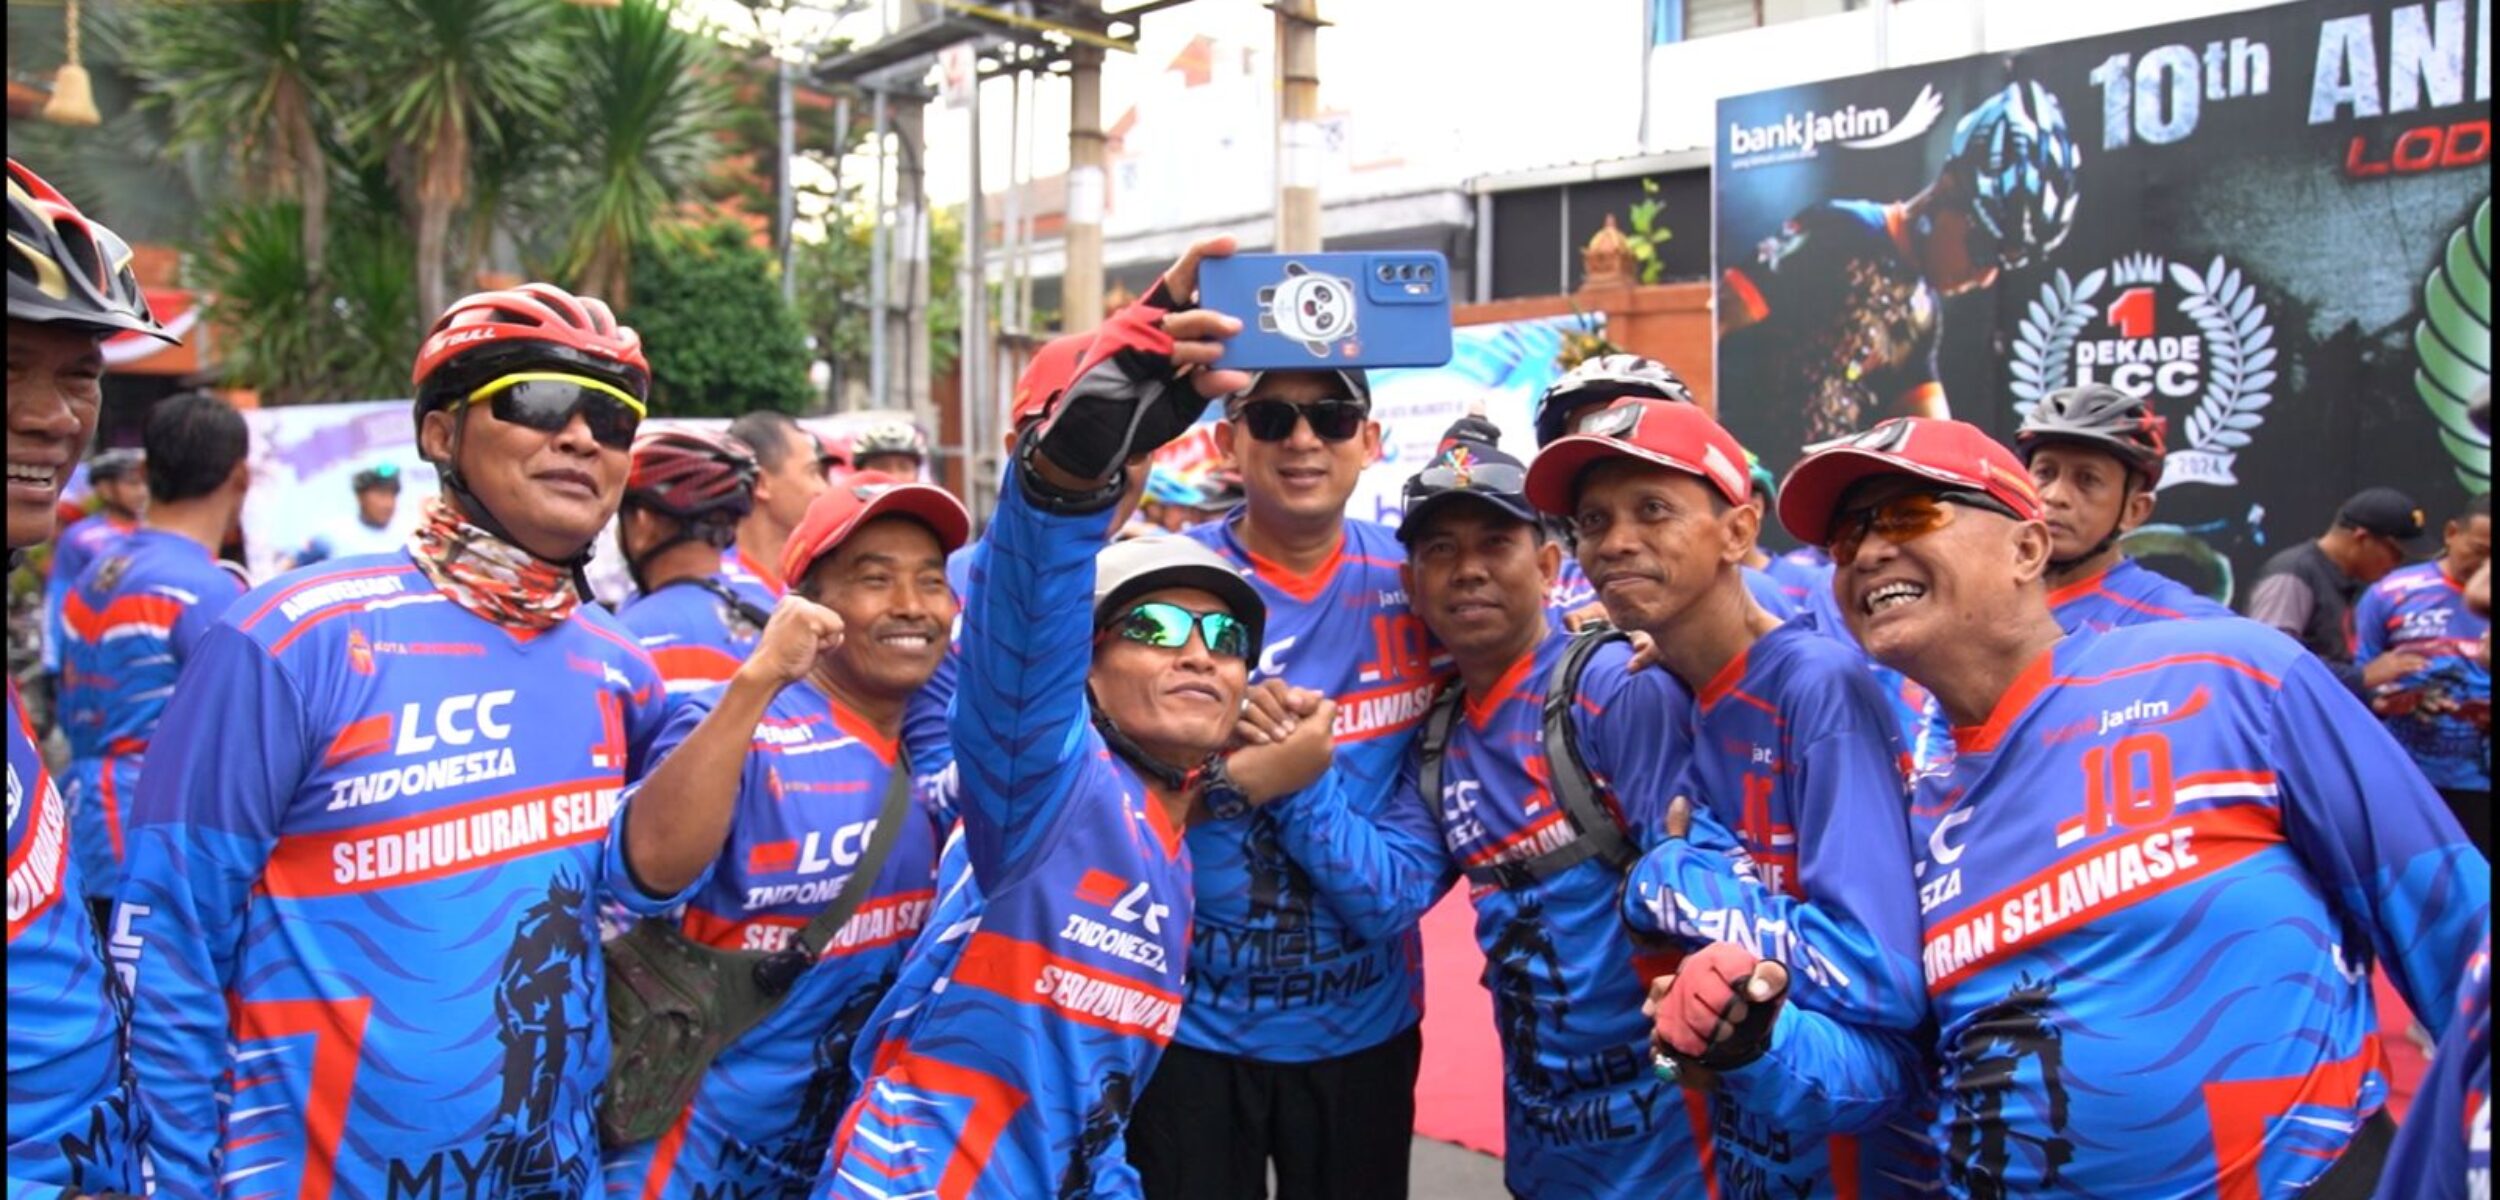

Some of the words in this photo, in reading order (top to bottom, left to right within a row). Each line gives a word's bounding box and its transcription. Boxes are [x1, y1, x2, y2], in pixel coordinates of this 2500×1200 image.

[2090, 37, 2270, 151] 10th
[1731, 106, 1890, 155] bankjatim
[2107, 287, 2156, 338] 1
[2076, 334, 2201, 366] DEKADE
[2178, 455, 2222, 476] 2024
[394, 689, 516, 757] LCC
[327, 746, 517, 812] INDONESIA
[2056, 731, 2175, 837] 10
[332, 799, 548, 885] SEDHULURAN
[2002, 826, 2200, 944] SELAWASE
